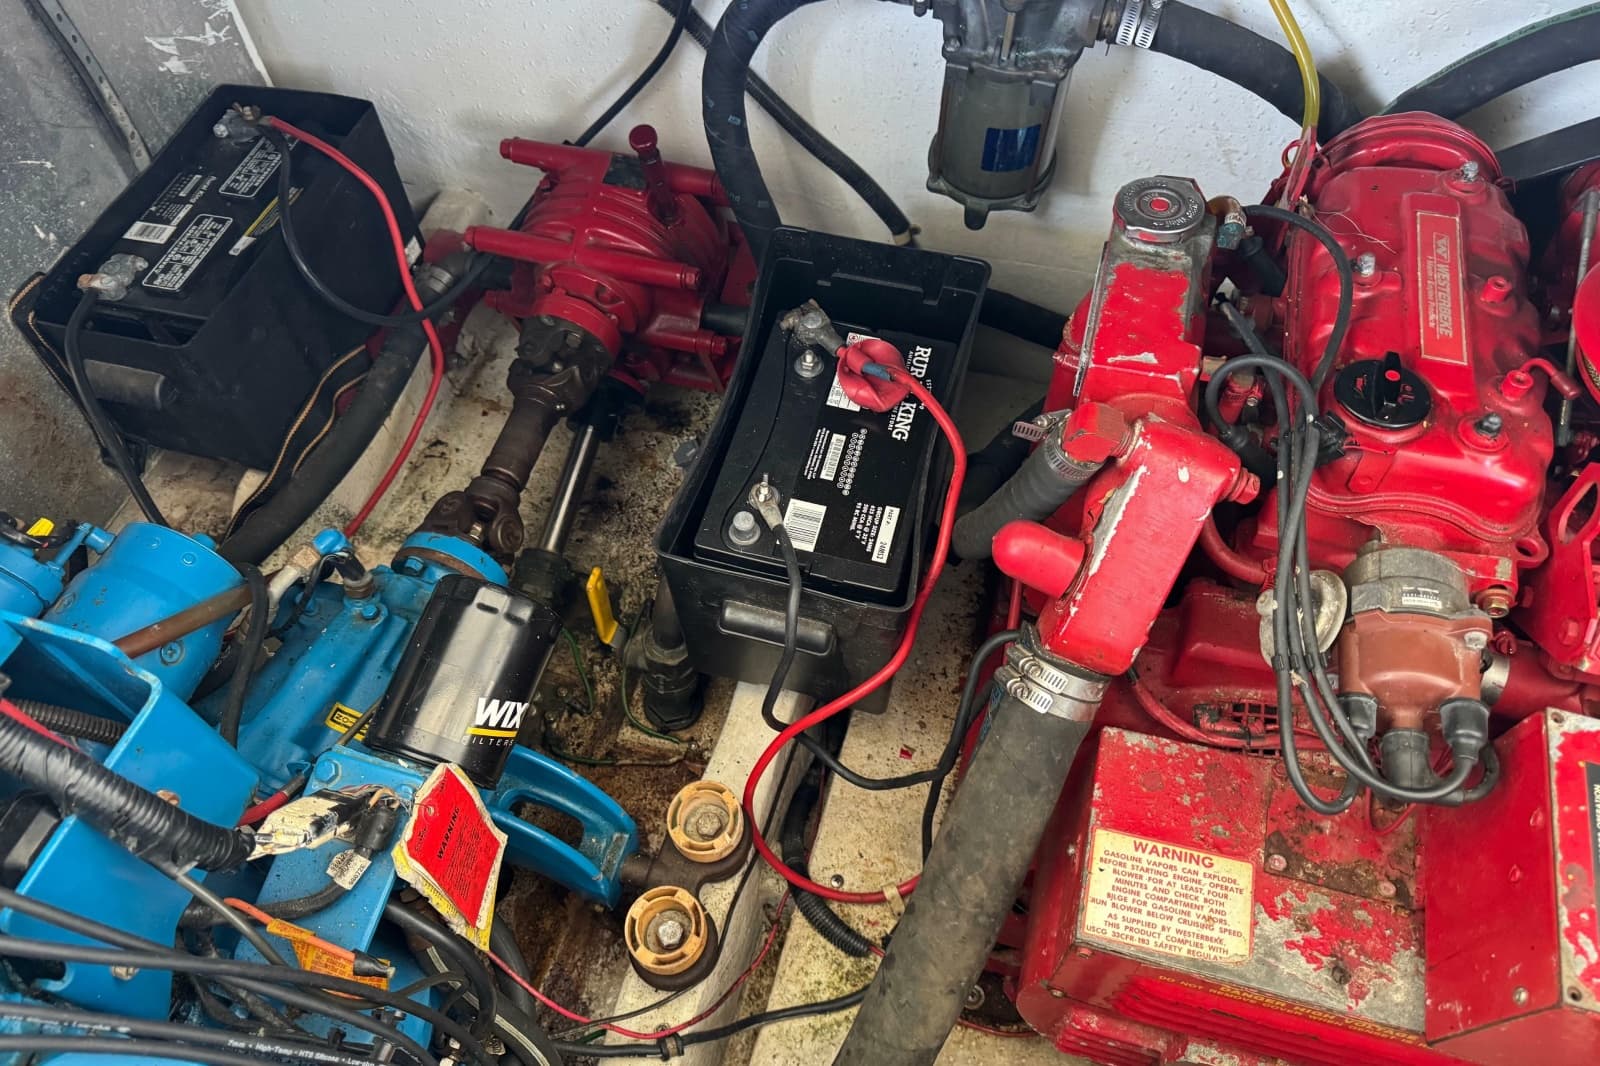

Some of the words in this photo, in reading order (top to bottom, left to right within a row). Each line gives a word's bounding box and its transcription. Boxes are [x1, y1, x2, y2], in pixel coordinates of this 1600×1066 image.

[1436, 263, 1452, 337] WESTERBEKE
[891, 399, 916, 442] KING
[475, 697, 528, 729] WIX
[436, 806, 461, 860] WARNING
[1103, 849, 1142, 863] GASOLINE
[1145, 858, 1178, 871] VAPORS
[1181, 867, 1198, 876] CAN
[1133, 840, 1215, 869] WARNING
[1099, 856, 1127, 868] BEFORE
[1130, 864, 1168, 878] STARTING
[1208, 881, 1244, 894] OPERATE
[1112, 868, 1143, 880] BLOWER
[1147, 876, 1163, 885] FOR
[1166, 880, 1177, 888] AT
[1207, 889, 1228, 899] FOUR
[1111, 884, 1140, 896] ENGINE
[1144, 892, 1204, 911] COMPARTMENT
[1208, 906, 1227, 916] AND
[1114, 877, 1148, 890] MINUTES
[1152, 885, 1169, 895] AND
[1174, 890, 1199, 901] CHECK
[1203, 897, 1225, 907] BOTH
[1131, 897, 1147, 907] FOR
[1151, 902, 1192, 917] GASOLINE
[1107, 912, 1118, 920] AS
[1121, 915, 1157, 929] SUPPLIED
[1160, 924, 1171, 933] BY
[1111, 901, 1142, 914] BLOWER
[1146, 909, 1173, 921] BELOW
[1177, 917, 1215, 931] CRUISING
[1085, 924, 1107, 935] USCG
[1153, 939, 1182, 953] SAFETY
[1186, 947, 1221, 962] REGULA
[1103, 920, 1120, 929] THIS
[1123, 925, 1160, 938] PRODUCT
[1165, 934, 1204, 949] COMPLIES
[1207, 943, 1229, 955] WITH
